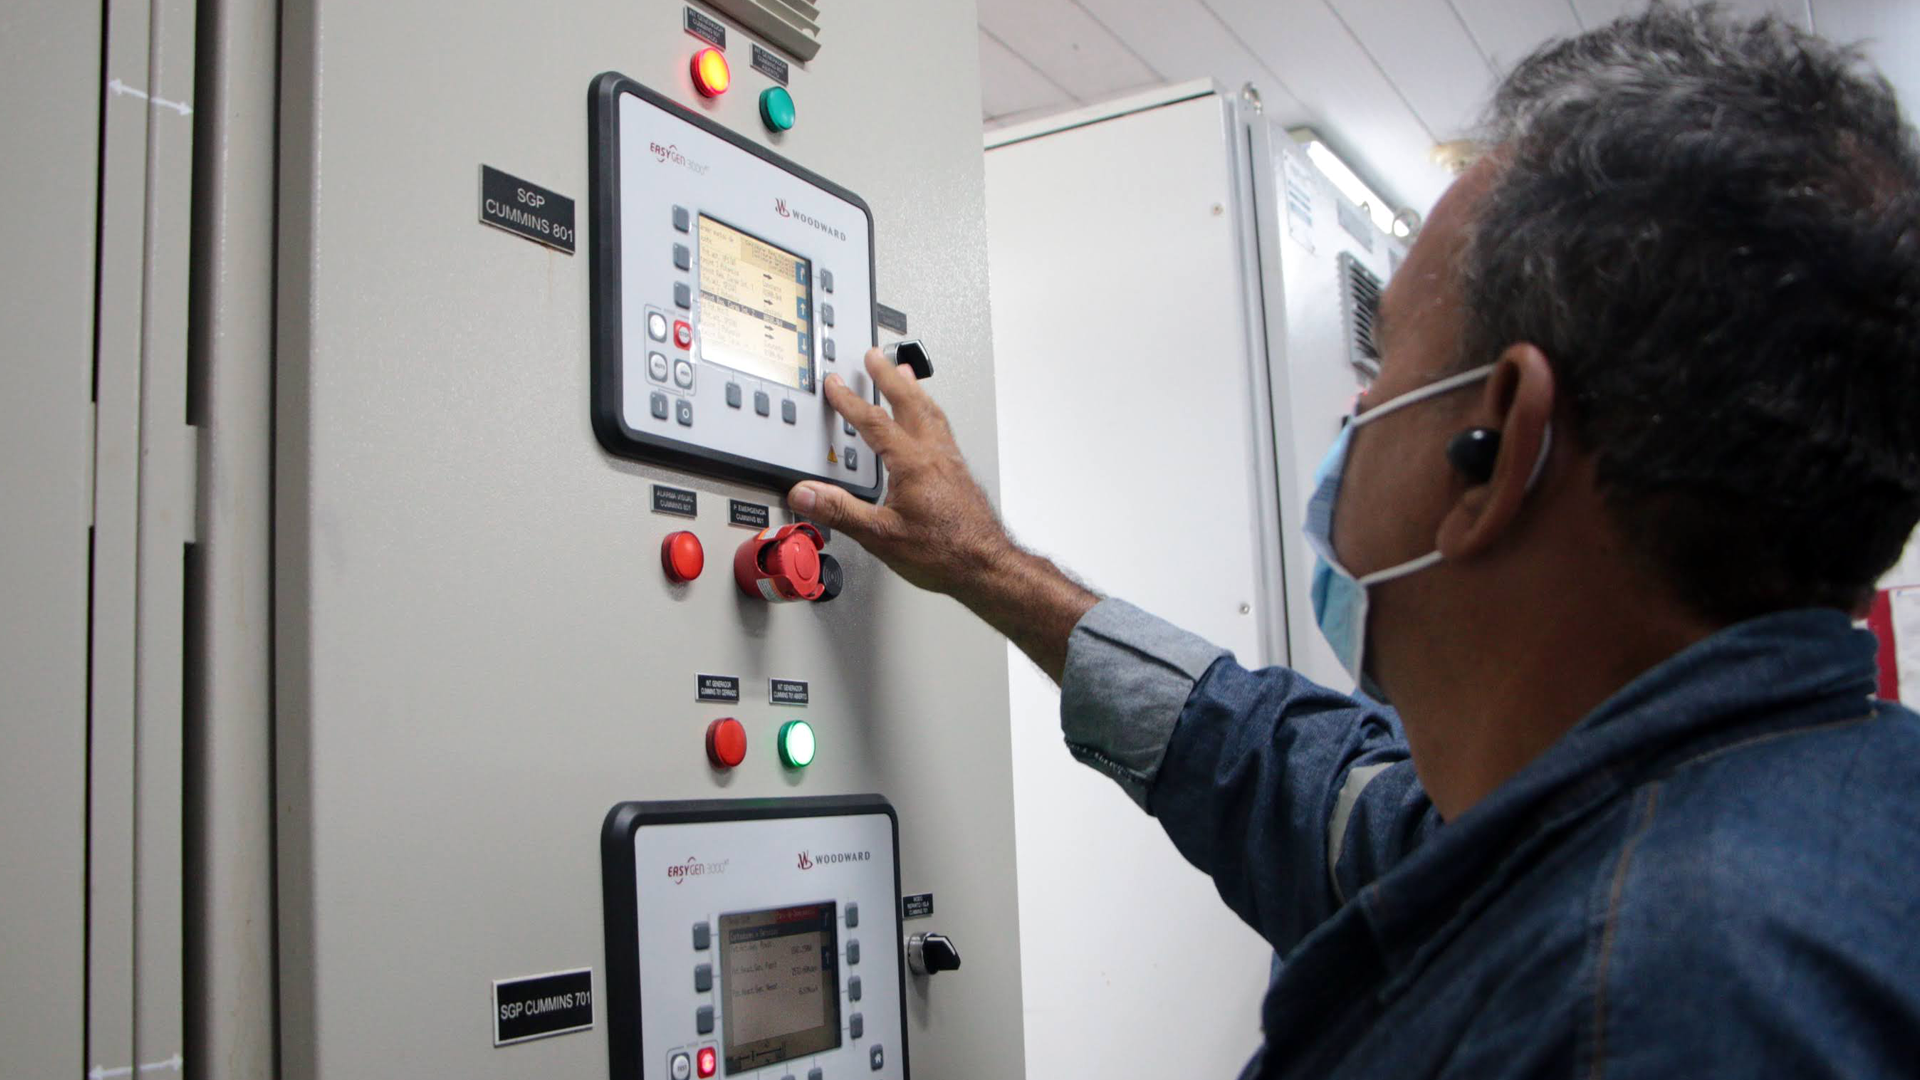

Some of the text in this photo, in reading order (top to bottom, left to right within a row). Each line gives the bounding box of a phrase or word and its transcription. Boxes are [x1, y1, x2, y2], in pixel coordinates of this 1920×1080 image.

[517, 188, 545, 208] SGP
[485, 199, 573, 243] CUMMINS 801
[792, 209, 847, 242] WOODWARD
[660, 500, 682, 511] CUMMINS
[738, 505, 767, 516] EMERGENCIA
[735, 513, 756, 523] CUMMINS
[815, 851, 871, 865] WOODWARD
[500, 991, 590, 1020] SGP CUMMINS 701
